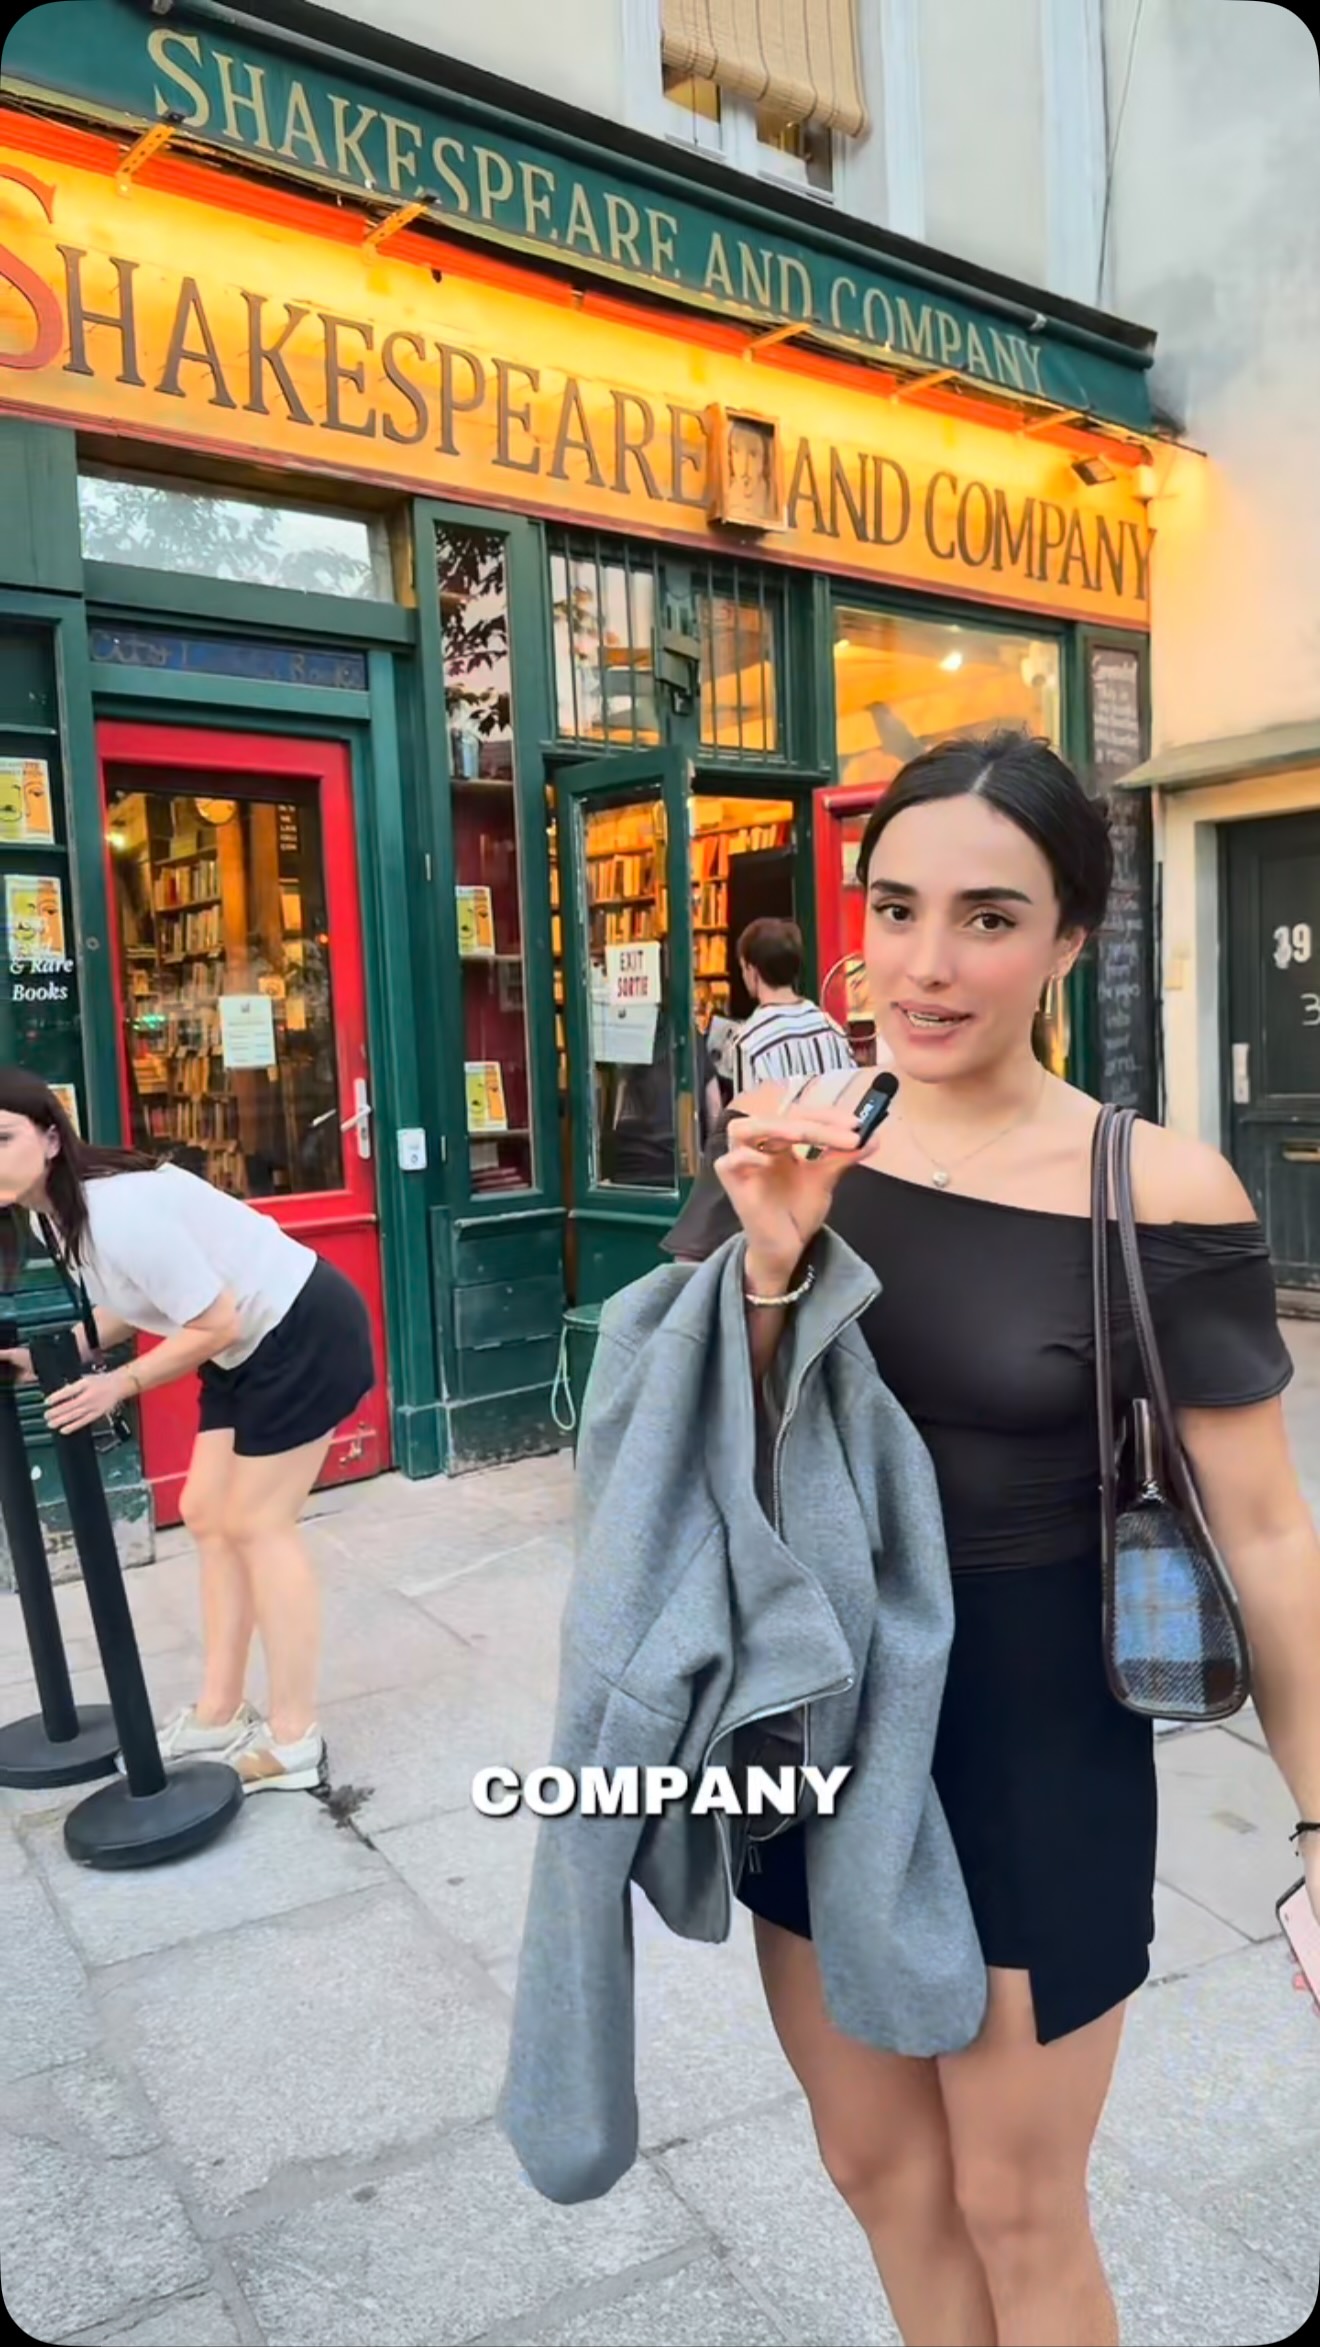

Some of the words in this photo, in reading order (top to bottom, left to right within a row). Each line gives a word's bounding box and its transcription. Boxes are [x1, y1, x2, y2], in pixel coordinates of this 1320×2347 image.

[146, 28, 682, 279] SHAKESPEARE
[703, 231, 813, 321] AND
[830, 276, 1047, 397] COMPANY
[786, 436, 910, 545] AND
[924, 471, 1158, 600] COMPANY
[9, 957, 25, 975] &
[30, 956, 74, 974] Rare
[620, 949, 644, 972] EXIT
[12, 981, 69, 1001] Books
[617, 976, 649, 997] SORTIE
